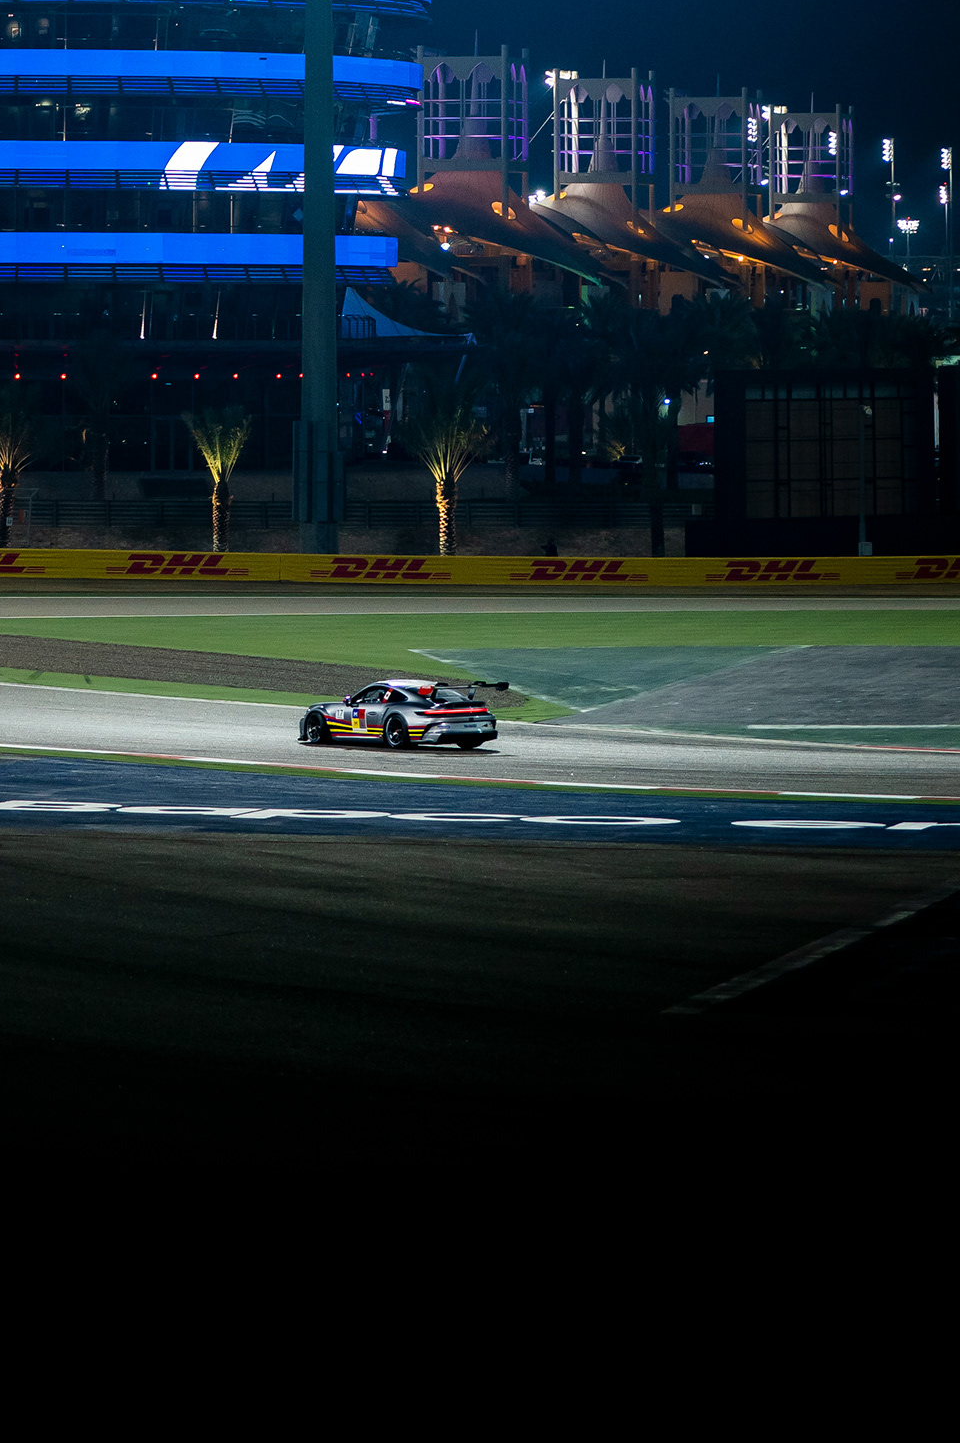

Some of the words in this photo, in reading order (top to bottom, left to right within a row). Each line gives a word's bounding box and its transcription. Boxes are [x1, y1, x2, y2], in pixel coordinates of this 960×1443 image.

[126, 554, 230, 576] DHL
[328, 557, 433, 580] DHL
[529, 560, 630, 582] DHL
[725, 560, 823, 582] DHL
